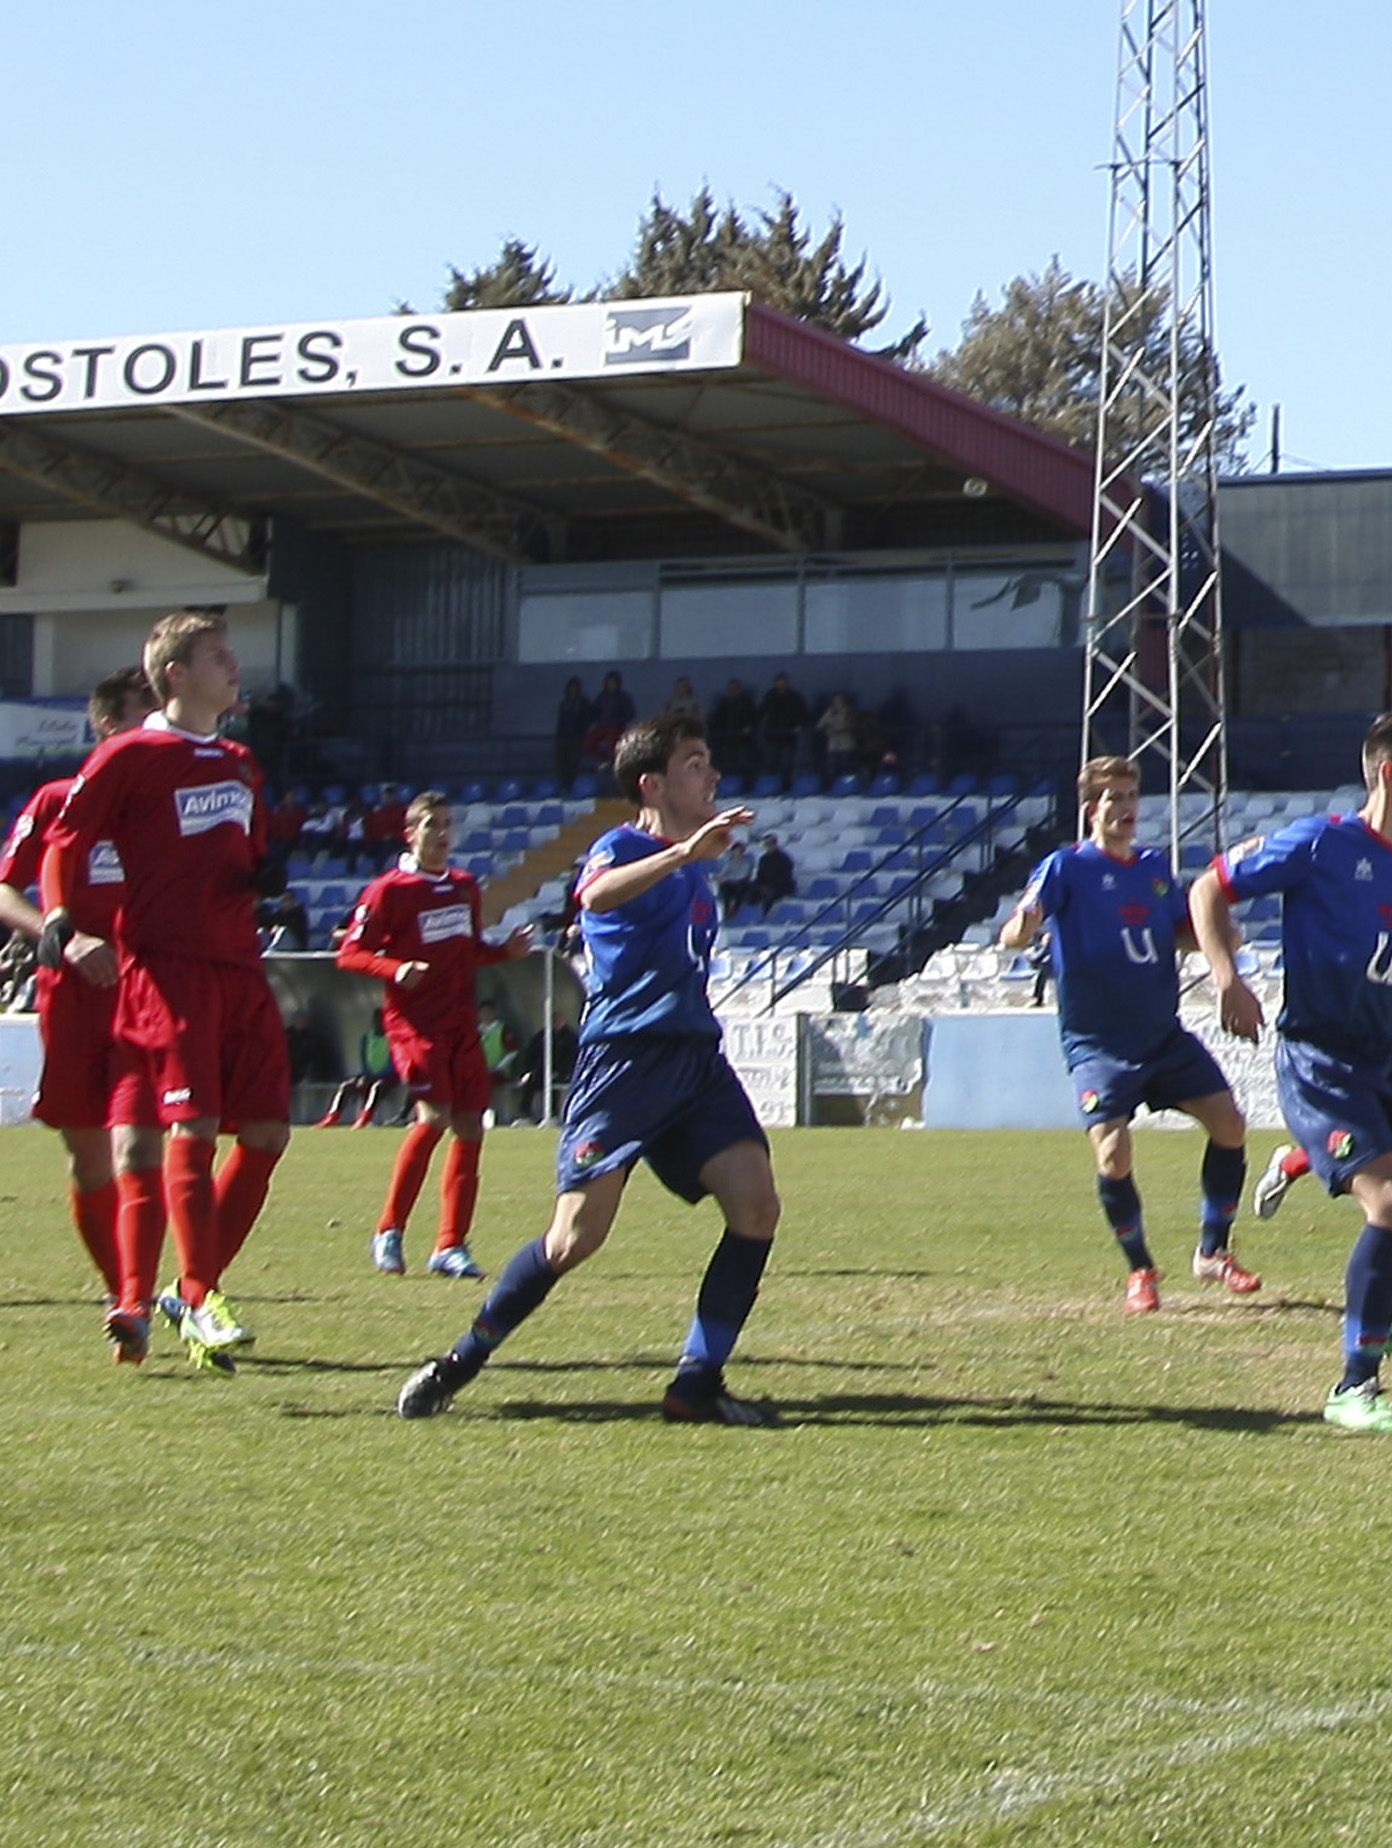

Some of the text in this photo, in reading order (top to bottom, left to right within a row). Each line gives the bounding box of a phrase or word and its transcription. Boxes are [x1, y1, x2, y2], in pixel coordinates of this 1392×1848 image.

[0, 317, 564, 403] STOLES, S. A.
